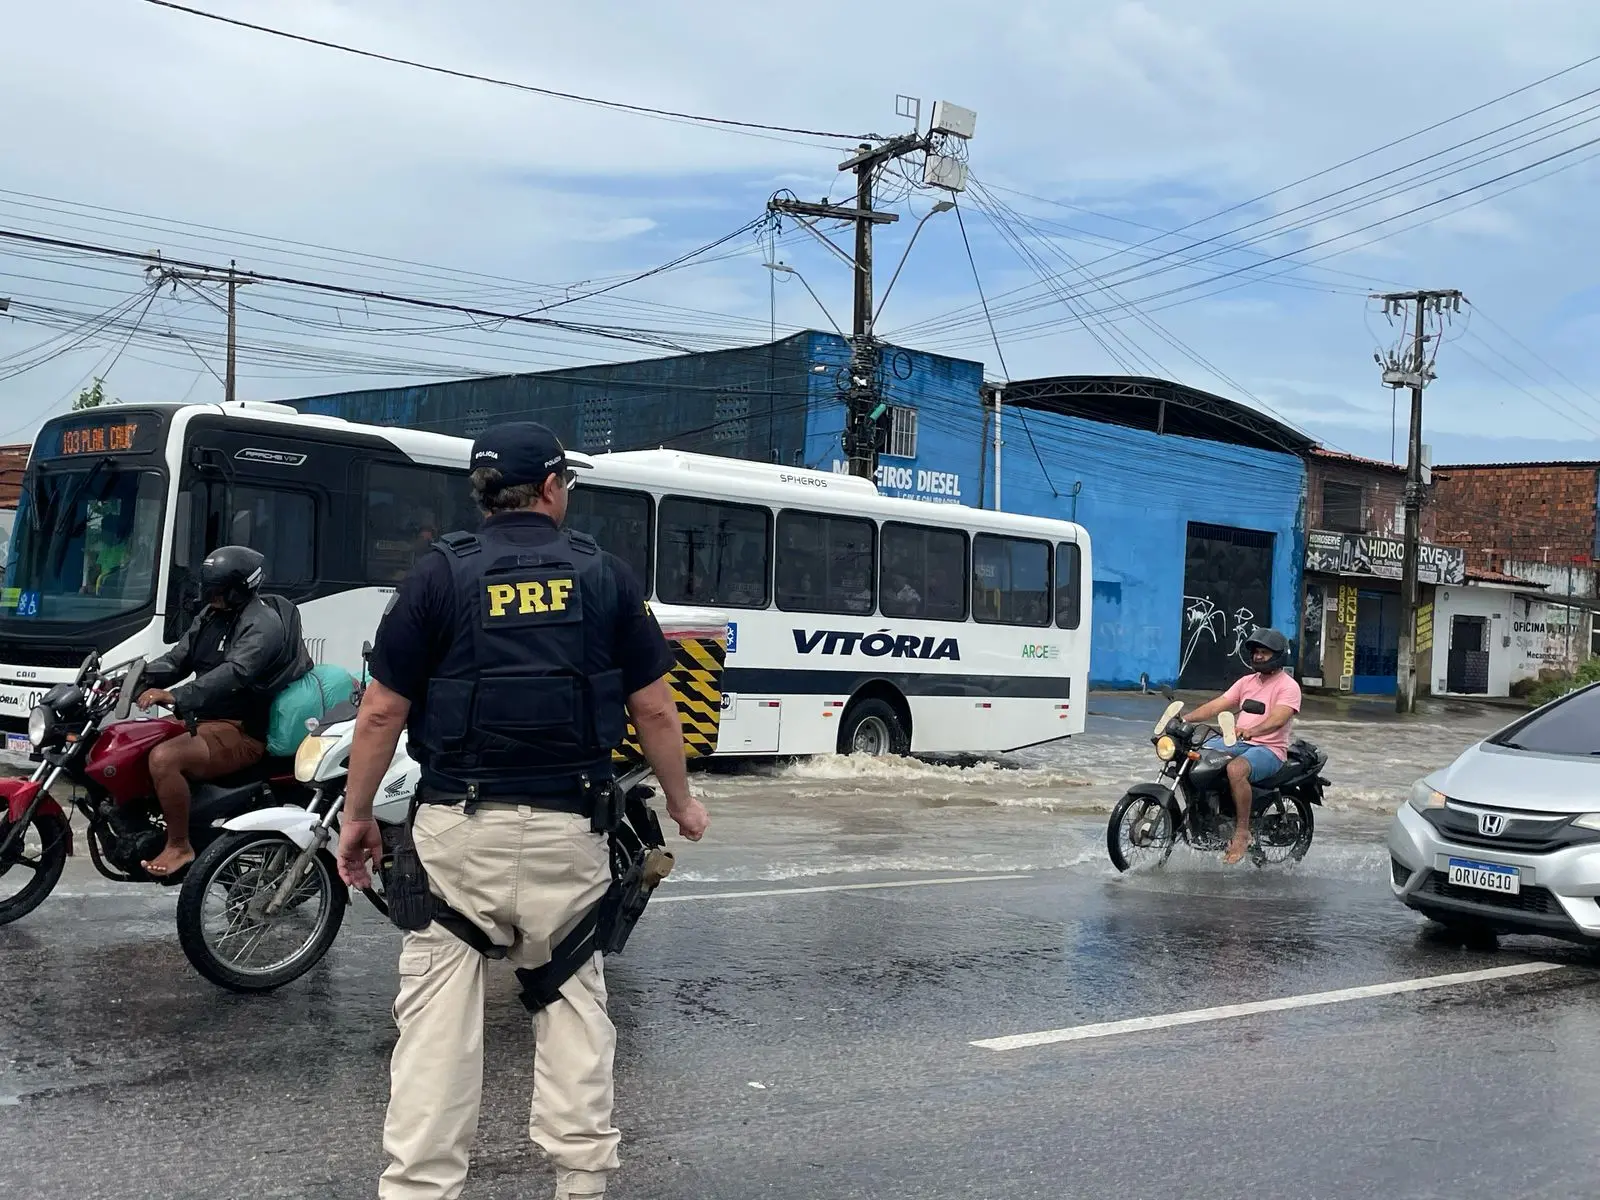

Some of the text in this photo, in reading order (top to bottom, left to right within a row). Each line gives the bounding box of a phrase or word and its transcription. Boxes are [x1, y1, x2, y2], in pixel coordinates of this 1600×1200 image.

[780, 474, 828, 488] SPHEROS
[832, 459, 961, 497] MEIROS DIESEL
[1368, 539, 1443, 565] HIDRORVE
[487, 579, 573, 616] PRF
[1513, 621, 1546, 633] OFICINA
[792, 628, 961, 661] VITÓRIA
[1021, 644, 1049, 659] ARCE
[385, 789, 410, 798] HONDA
[1455, 868, 1511, 890] ORV6G10
